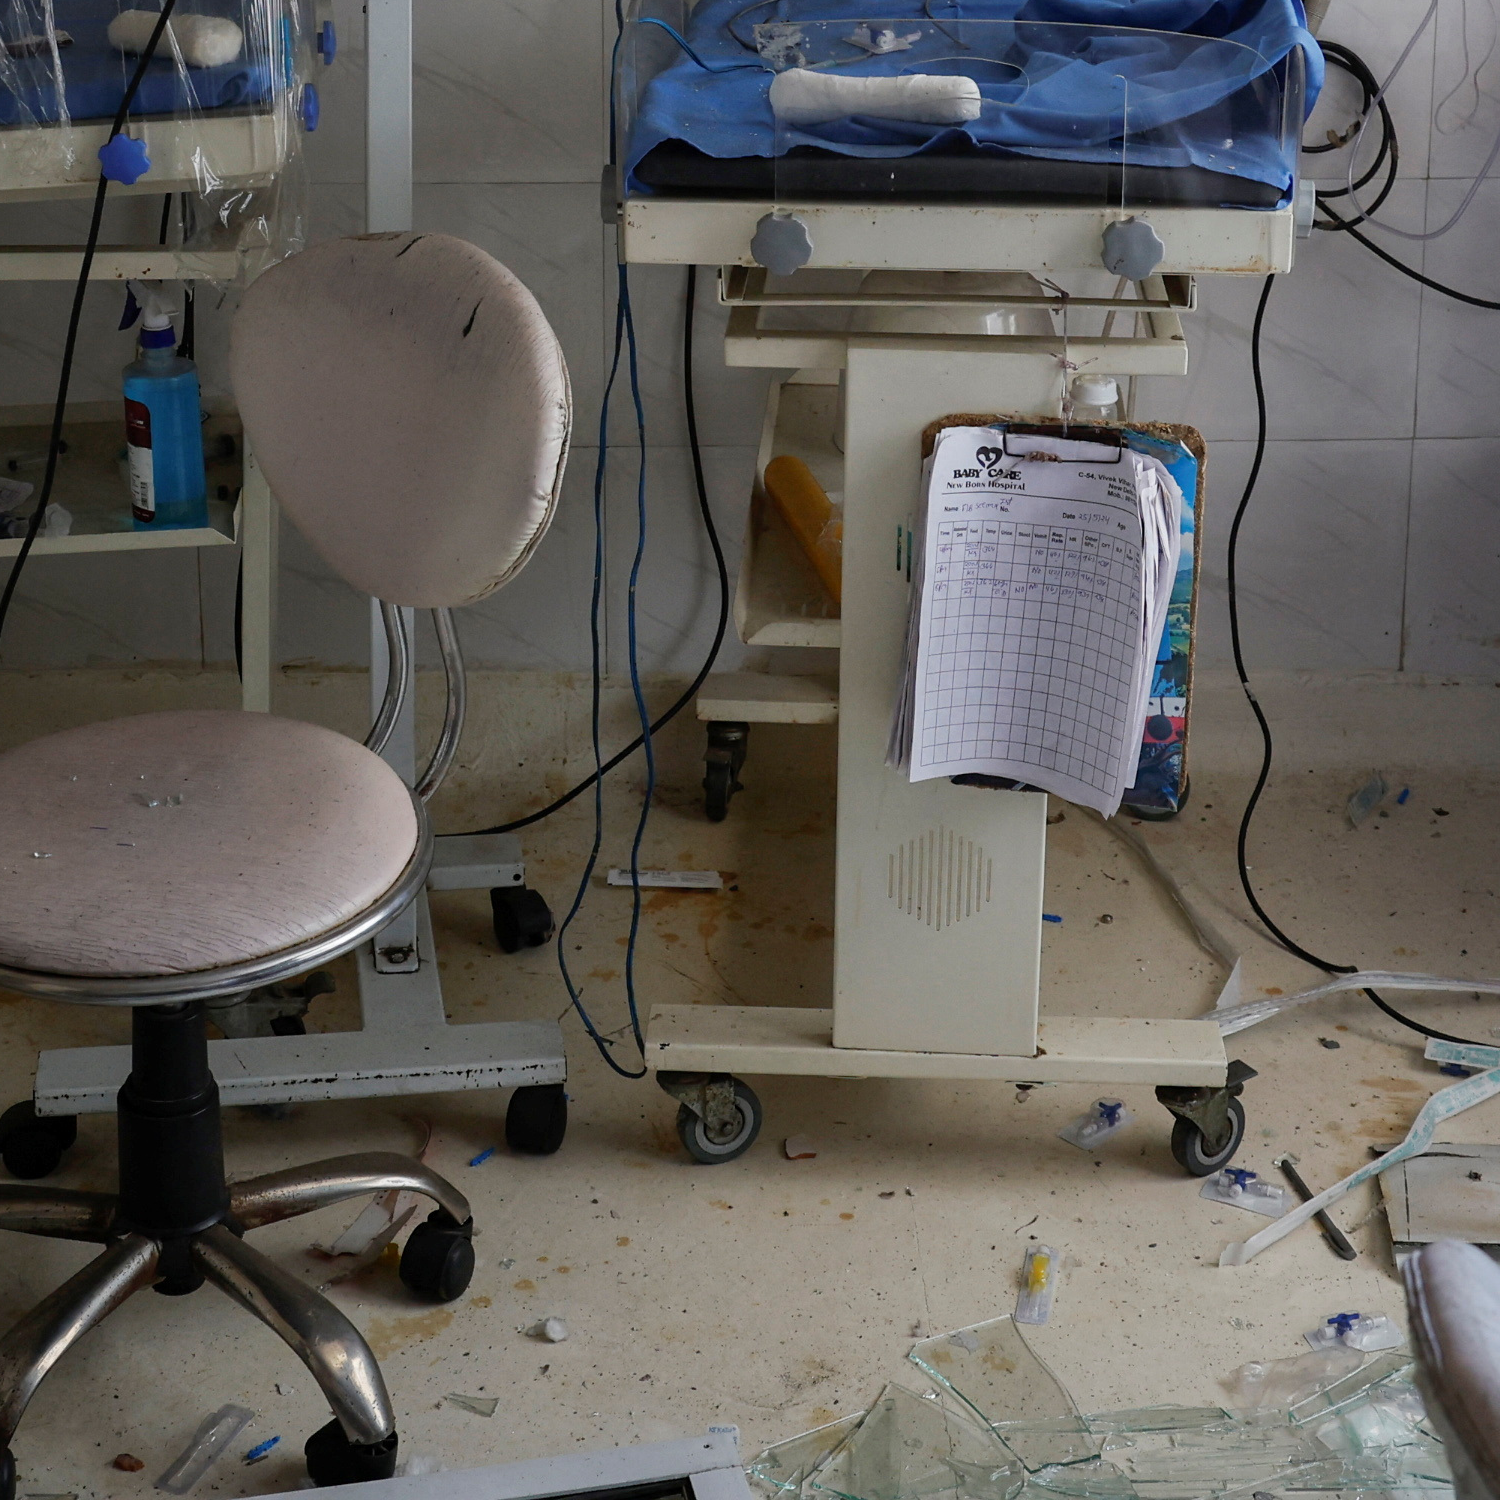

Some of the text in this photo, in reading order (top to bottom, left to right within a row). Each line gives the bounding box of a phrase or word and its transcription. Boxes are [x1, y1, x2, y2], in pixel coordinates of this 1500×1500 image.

[953, 469, 1022, 481] BABY CARE
[1108, 483, 1122, 491] New
